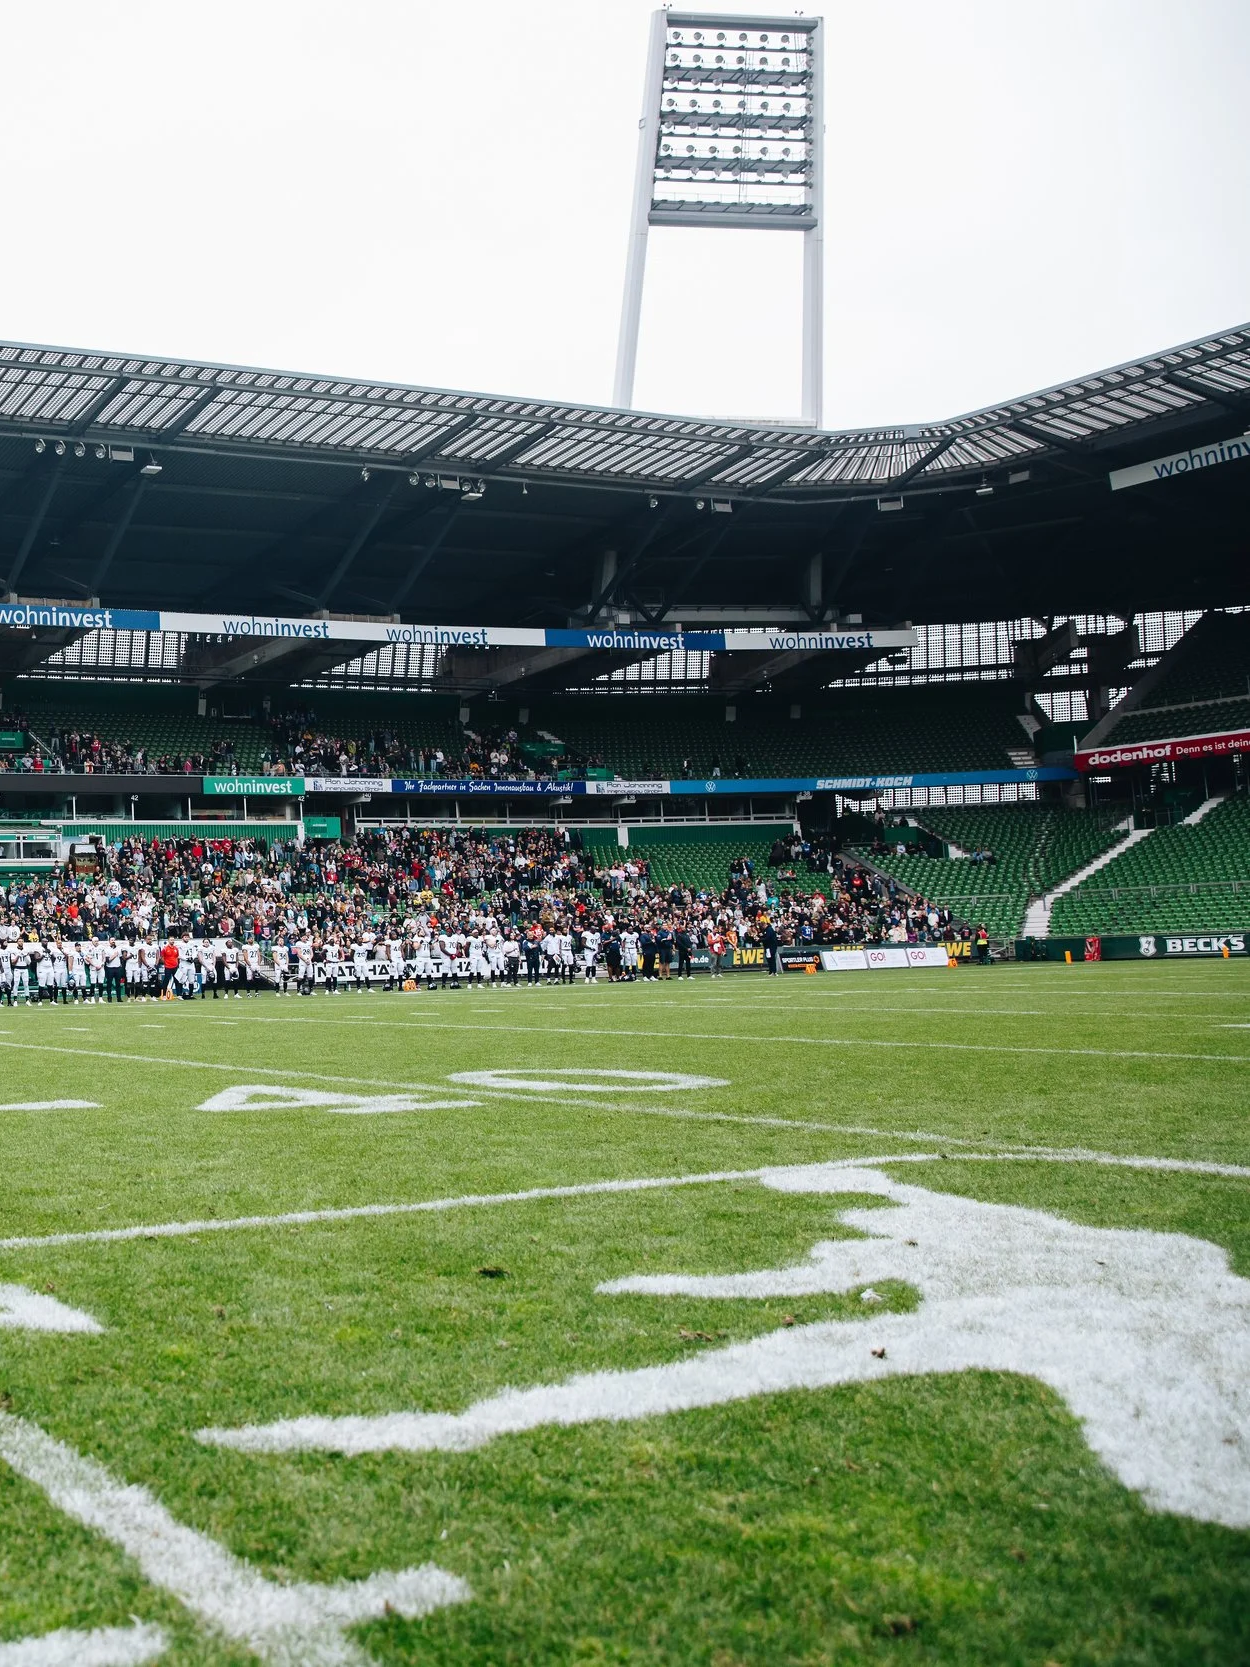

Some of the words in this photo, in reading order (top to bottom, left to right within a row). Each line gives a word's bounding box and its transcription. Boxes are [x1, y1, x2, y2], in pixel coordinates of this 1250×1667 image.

[223, 616, 329, 639] wohninvest
[386, 624, 488, 646] wohninvest
[586, 630, 685, 650] wohninvest
[768, 631, 874, 650] wohninvest
[1088, 745, 1172, 766] dodenhof
[1175, 745, 1200, 755] Denn
[1202, 744, 1213, 752] es
[1214, 741, 1226, 750] ist
[214, 779, 292, 794] wohninvest
[417, 781, 457, 793] Fachpartner
[468, 782, 491, 792] Sachen
[536, 783, 542, 791] &
[544, 782, 574, 792] Akustik!
[130, 794, 139, 802] 42
[1165, 934, 1245, 952] BECK'S
[77, 958, 85, 966] 19
[733, 949, 764, 965] EWE
[870, 952, 886, 962] GO!
[910, 951, 926, 960] GO!
